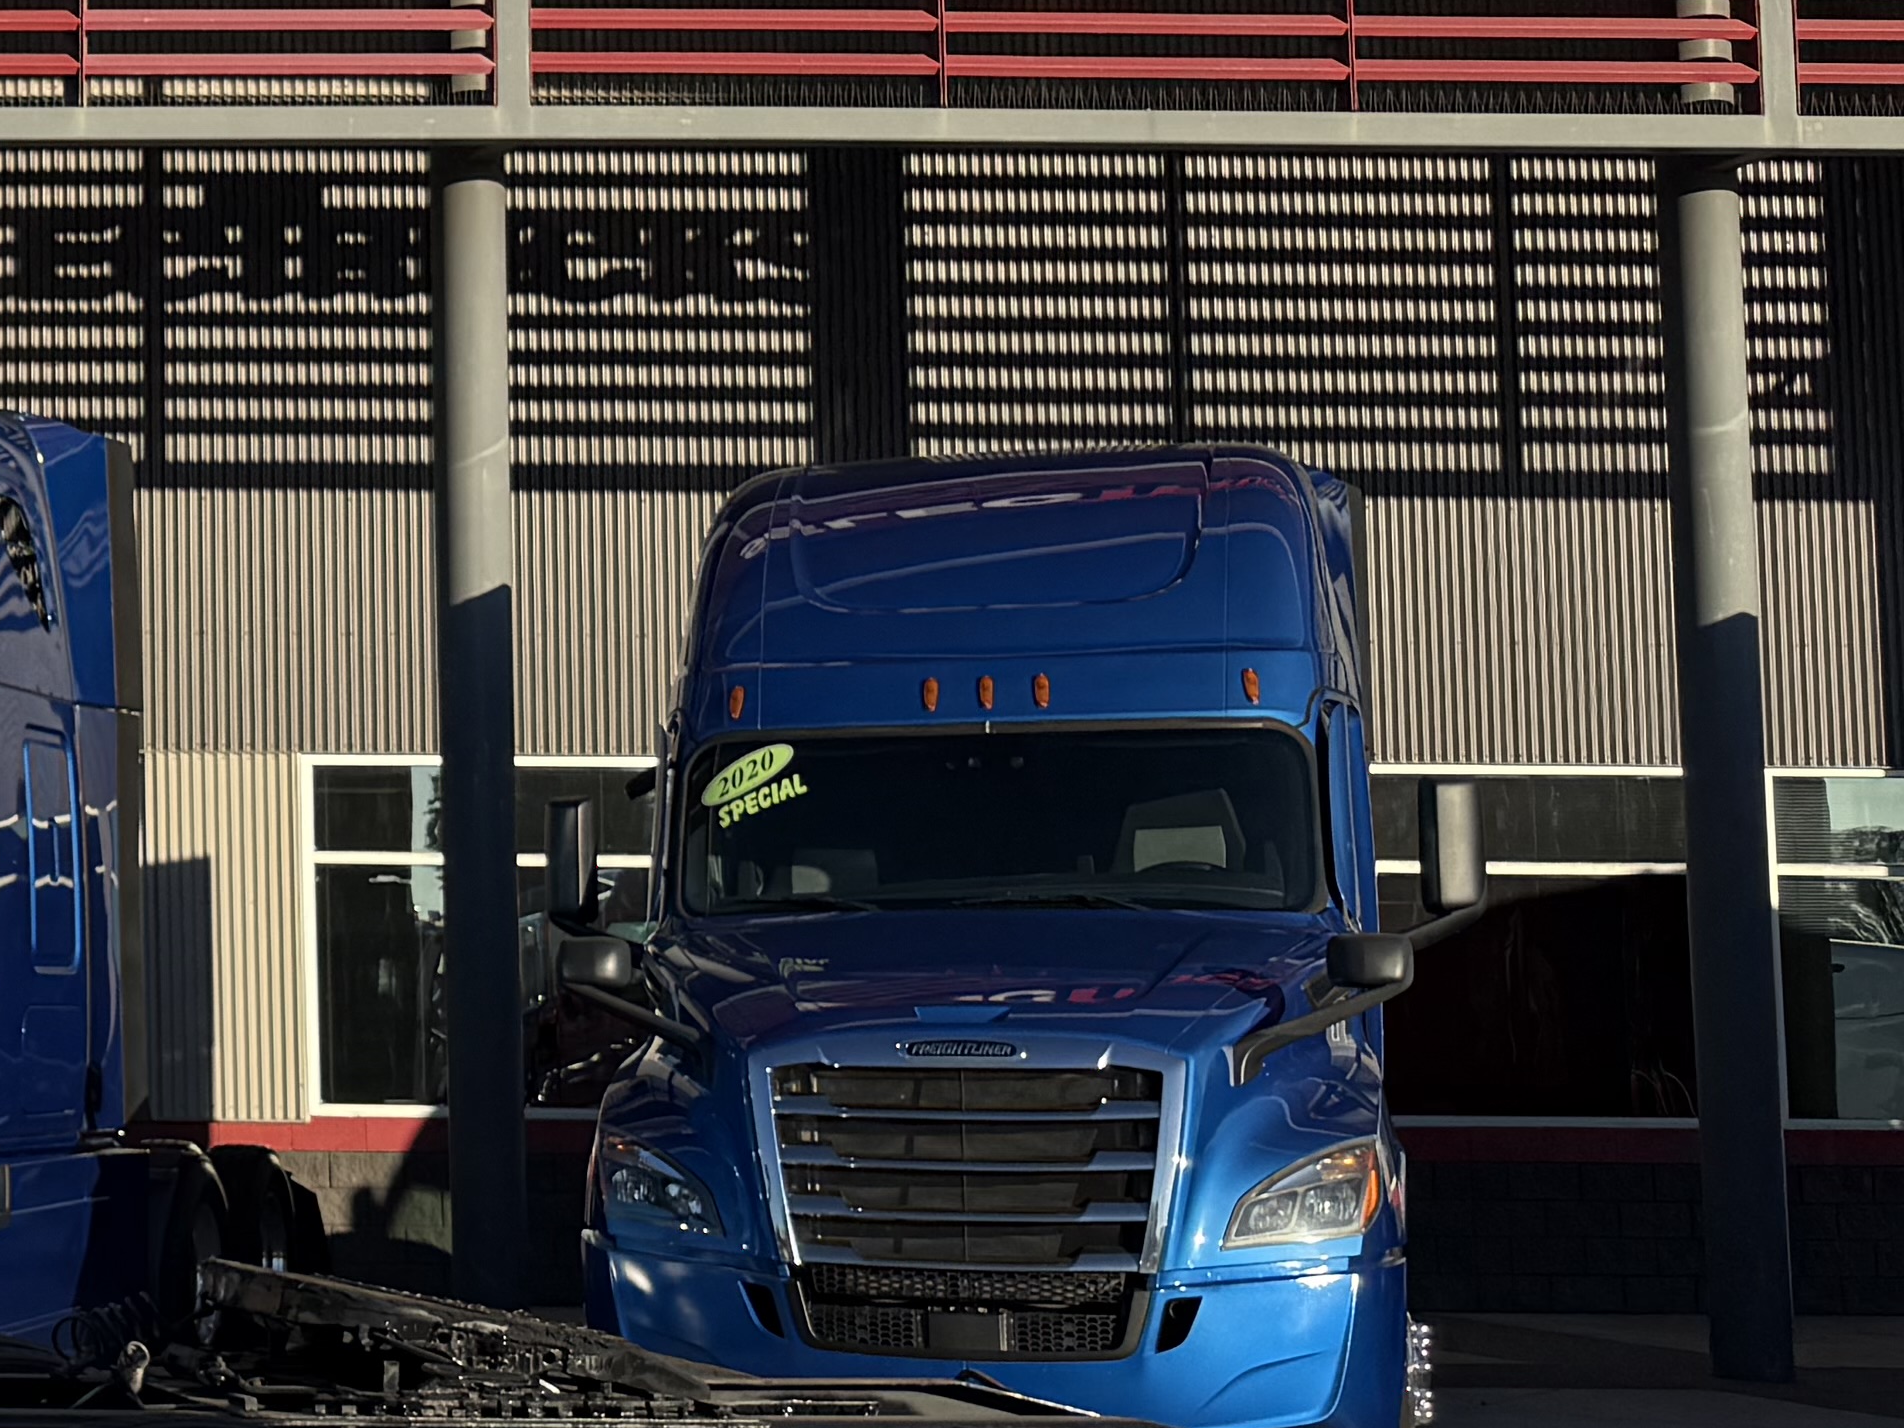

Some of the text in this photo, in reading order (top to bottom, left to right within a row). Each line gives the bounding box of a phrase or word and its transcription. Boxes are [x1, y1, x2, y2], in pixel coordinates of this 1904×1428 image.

[718, 749, 774, 799] 2020
[718, 773, 808, 829] SPECIAL
[911, 1042, 1012, 1055] FREIGHTLINER
